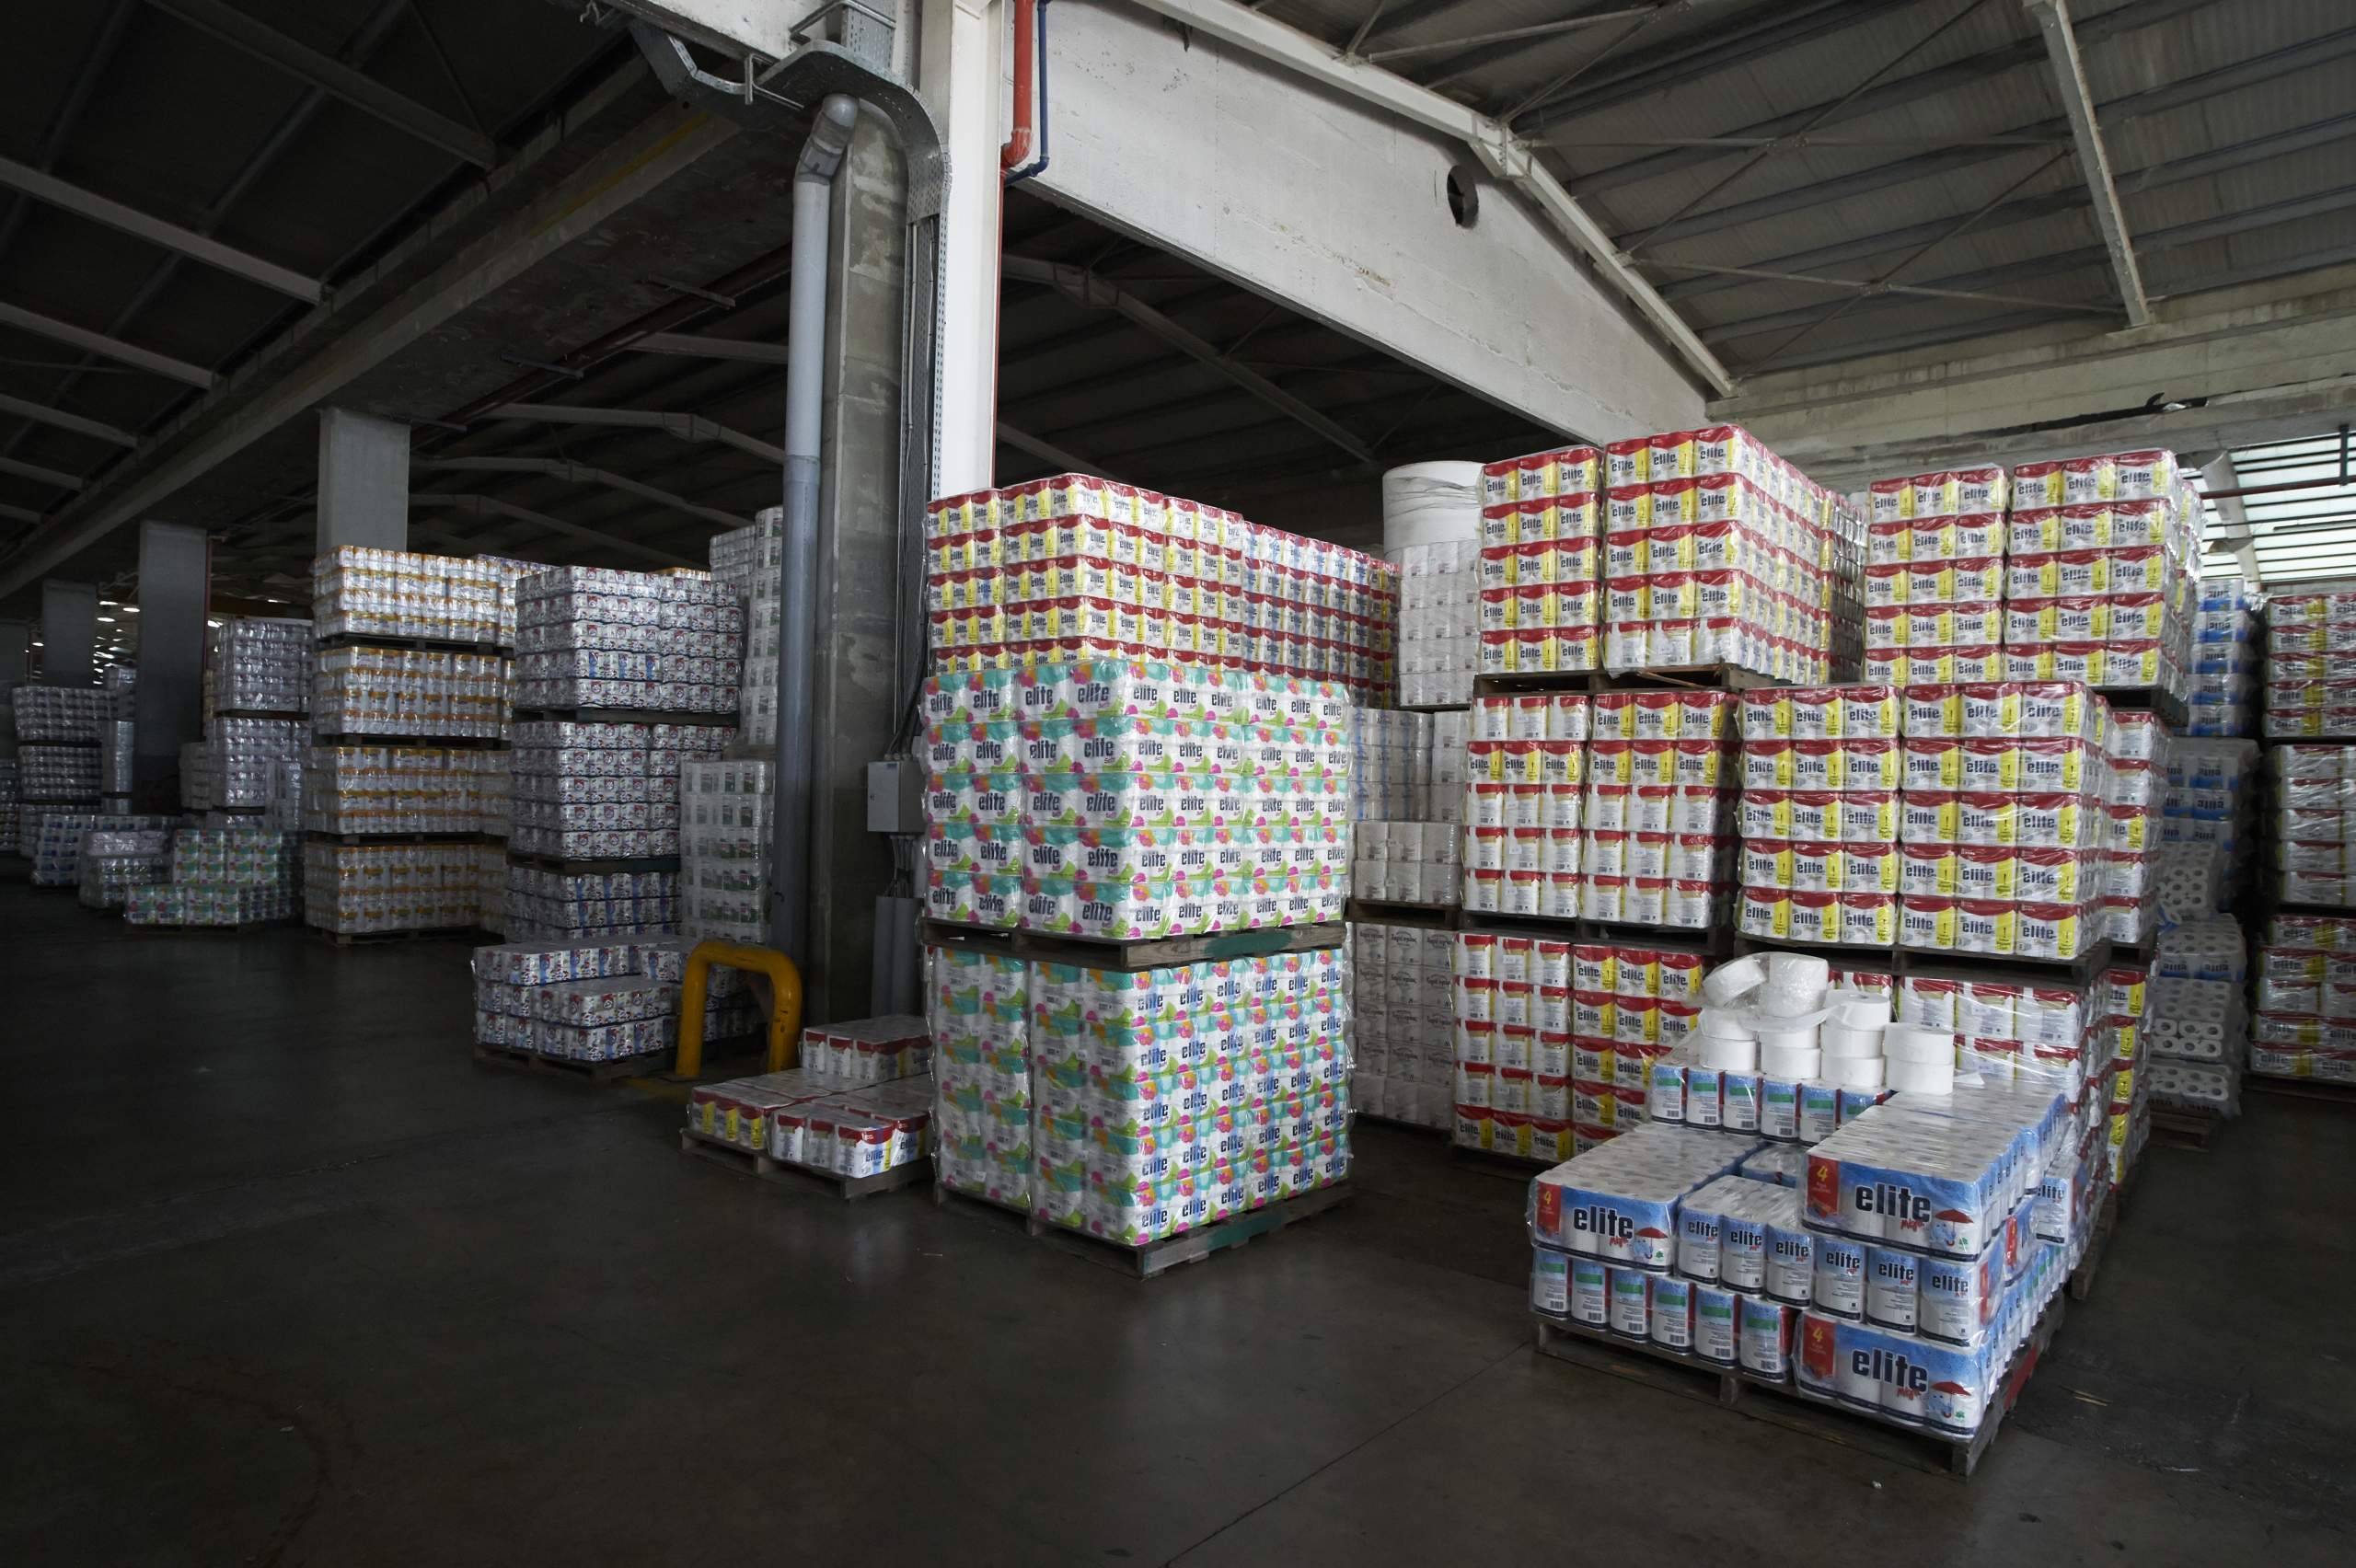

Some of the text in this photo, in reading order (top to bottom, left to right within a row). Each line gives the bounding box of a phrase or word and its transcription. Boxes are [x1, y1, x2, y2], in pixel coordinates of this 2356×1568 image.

[1653, 453, 1676, 465] elite
[1700, 446, 1725, 459] elite
[1611, 459, 1634, 471] elite
[1521, 474, 1541, 485] elite
[1563, 469, 1583, 479] elite
[1655, 500, 1678, 512] elite
[1702, 495, 1725, 506] elite
[1612, 506, 1635, 516] elite
[1521, 518, 1542, 529] elite
[1610, 549, 1633, 562] elite
[1653, 547, 1676, 558] elite
[1484, 563, 1504, 574] elite
[1519, 559, 1540, 571] elite
[1611, 594, 1634, 606] elite
[1655, 594, 1677, 604] elite
[1701, 588, 1726, 601] elite
[1484, 607, 1503, 617] elite
[1521, 604, 1542, 614] elite
[1562, 601, 1582, 611] elite
[1484, 648, 1503, 659] elite
[1519, 646, 1541, 658] elite
[1563, 646, 1583, 656] elite
[974, 690, 999, 708] elite
[1026, 686, 1053, 705] elite
[1079, 684, 1109, 702] elite
[1134, 686, 1157, 700] elite
[1174, 689, 1195, 703] elite
[930, 694, 953, 711] elite
[1292, 700, 1310, 713] elite
[1324, 703, 1341, 716] elite
[1748, 711, 1772, 721] elite
[1850, 709, 1876, 721] elite
[1911, 708, 1939, 718] elite
[1968, 706, 1996, 718] elite
[1639, 714, 1660, 723] elite
[1686, 713, 1708, 723] elite
[933, 744, 954, 760] elite
[976, 742, 1000, 758] elite
[1030, 741, 1057, 760] elite
[1084, 738, 1114, 757] elite
[1139, 741, 1162, 755] elite
[1180, 743, 1202, 756] elite
[1296, 749, 1314, 762] elite
[1471, 760, 1488, 768] elite
[1506, 759, 1524, 768] elite
[1546, 760, 1565, 769] elite
[1595, 760, 1615, 769] elite
[1635, 759, 1657, 769] elite
[1680, 760, 1703, 770] elite
[1749, 762, 1773, 772] elite
[1798, 762, 1825, 772] elite
[1852, 761, 1878, 772] elite
[1910, 760, 1939, 771] elite
[1967, 761, 1998, 773] elite
[979, 793, 1005, 810] elite
[1034, 793, 1059, 810] elite
[1087, 793, 1114, 812] elite
[1140, 796, 1163, 810] elite
[1182, 799, 1203, 810] elite
[1296, 799, 1314, 812] elite
[1796, 813, 1821, 823] elite
[1908, 813, 1934, 824] elite
[2025, 816, 2054, 828] elite
[935, 840, 957, 857] elite
[981, 843, 1006, 860] elite
[1296, 848, 1313, 861] elite
[1034, 847, 1059, 864] elite
[1089, 848, 1117, 867] elite
[1142, 853, 1165, 867] elite
[1182, 850, 1204, 865] elite
[1750, 859, 1773, 870] elite
[1797, 862, 1823, 873] elite
[1851, 864, 1877, 874] elite
[1907, 866, 1936, 877] elite
[933, 888, 955, 905] elite
[1029, 896, 1055, 915] elite
[1082, 903, 1112, 921] elite
[1179, 904, 1201, 917] elite
[1747, 907, 1771, 919] elite
[1794, 913, 1820, 924] elite
[1846, 915, 1874, 926] elite
[1906, 917, 1933, 929] elite
[1963, 921, 1993, 934] elite
[2023, 926, 2055, 939] elite
[1289, 976, 1308, 990] elite
[1181, 988, 1203, 1005] elite
[1255, 1029, 1276, 1043] elite
[1183, 1041, 1205, 1058] elite
[1141, 1048, 1166, 1066] elite
[1291, 1071, 1311, 1088] elite
[1184, 1092, 1207, 1112] elite
[1293, 1118, 1312, 1136] elite
[1260, 1126, 1279, 1144] elite
[1221, 1135, 1243, 1154] elite
[1294, 1167, 1312, 1184] elite
[1817, 1166, 1830, 1182] 4
[1259, 1173, 1279, 1193] elite
[1222, 1186, 1243, 1205] elite
[1542, 1190, 1553, 1205] 4
[1183, 1198, 1206, 1216] elite
[1854, 1183, 1931, 1224] elite
[1573, 1207, 1634, 1242] elite
[1688, 1221, 1718, 1237] elite
[1730, 1230, 1761, 1248] elite
[1776, 1240, 1809, 1259] elite
[1825, 1251, 1860, 1268] elite
[1878, 1262, 1913, 1280] elite
[1933, 1274, 1969, 1294] elite
[1812, 1327, 1823, 1343] 4
[1851, 1351, 1928, 1392] elite
